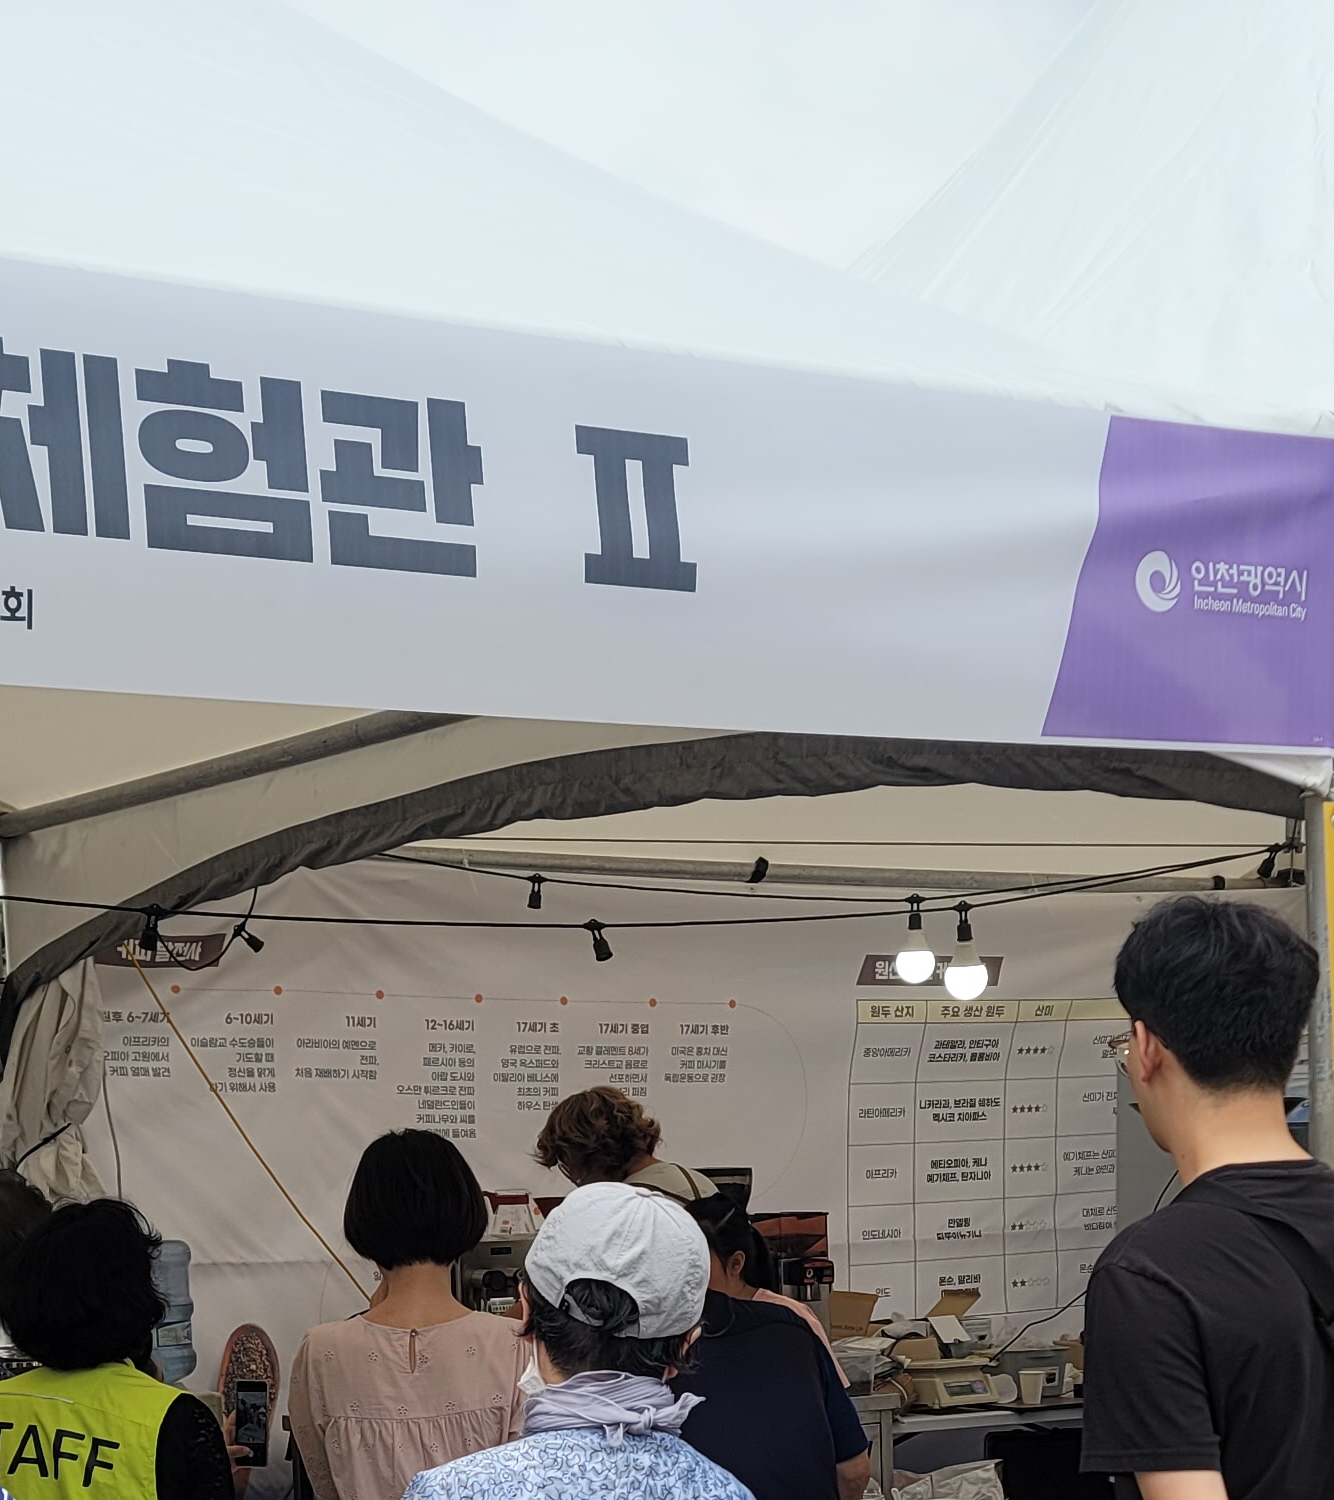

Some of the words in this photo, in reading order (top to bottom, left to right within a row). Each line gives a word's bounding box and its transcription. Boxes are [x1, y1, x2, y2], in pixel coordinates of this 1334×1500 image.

[1191, 561, 1308, 602] 인천광역시
[1193, 596, 1231, 613] Incheon
[1232, 599, 1288, 618] Metropolitan
[1289, 603, 1308, 622] City
[870, 1005, 891, 1018] 원두
[893, 1005, 915, 1018] 산지
[940, 1005, 961, 1018] 주요
[963, 1005, 983, 1018] 생산
[985, 1005, 1005, 1017] 원두
[1035, 1005, 1054, 1016] 산미
[225, 1012, 274, 1025] 6~10세기
[345, 1015, 377, 1028] 11세기
[425, 1019, 475, 1031] 12~16세기
[516, 1021, 547, 1033] 17세기
[549, 1022, 559, 1033] 초
[598, 1022, 628, 1034] 17세기
[680, 1024, 708, 1036] 17세기
